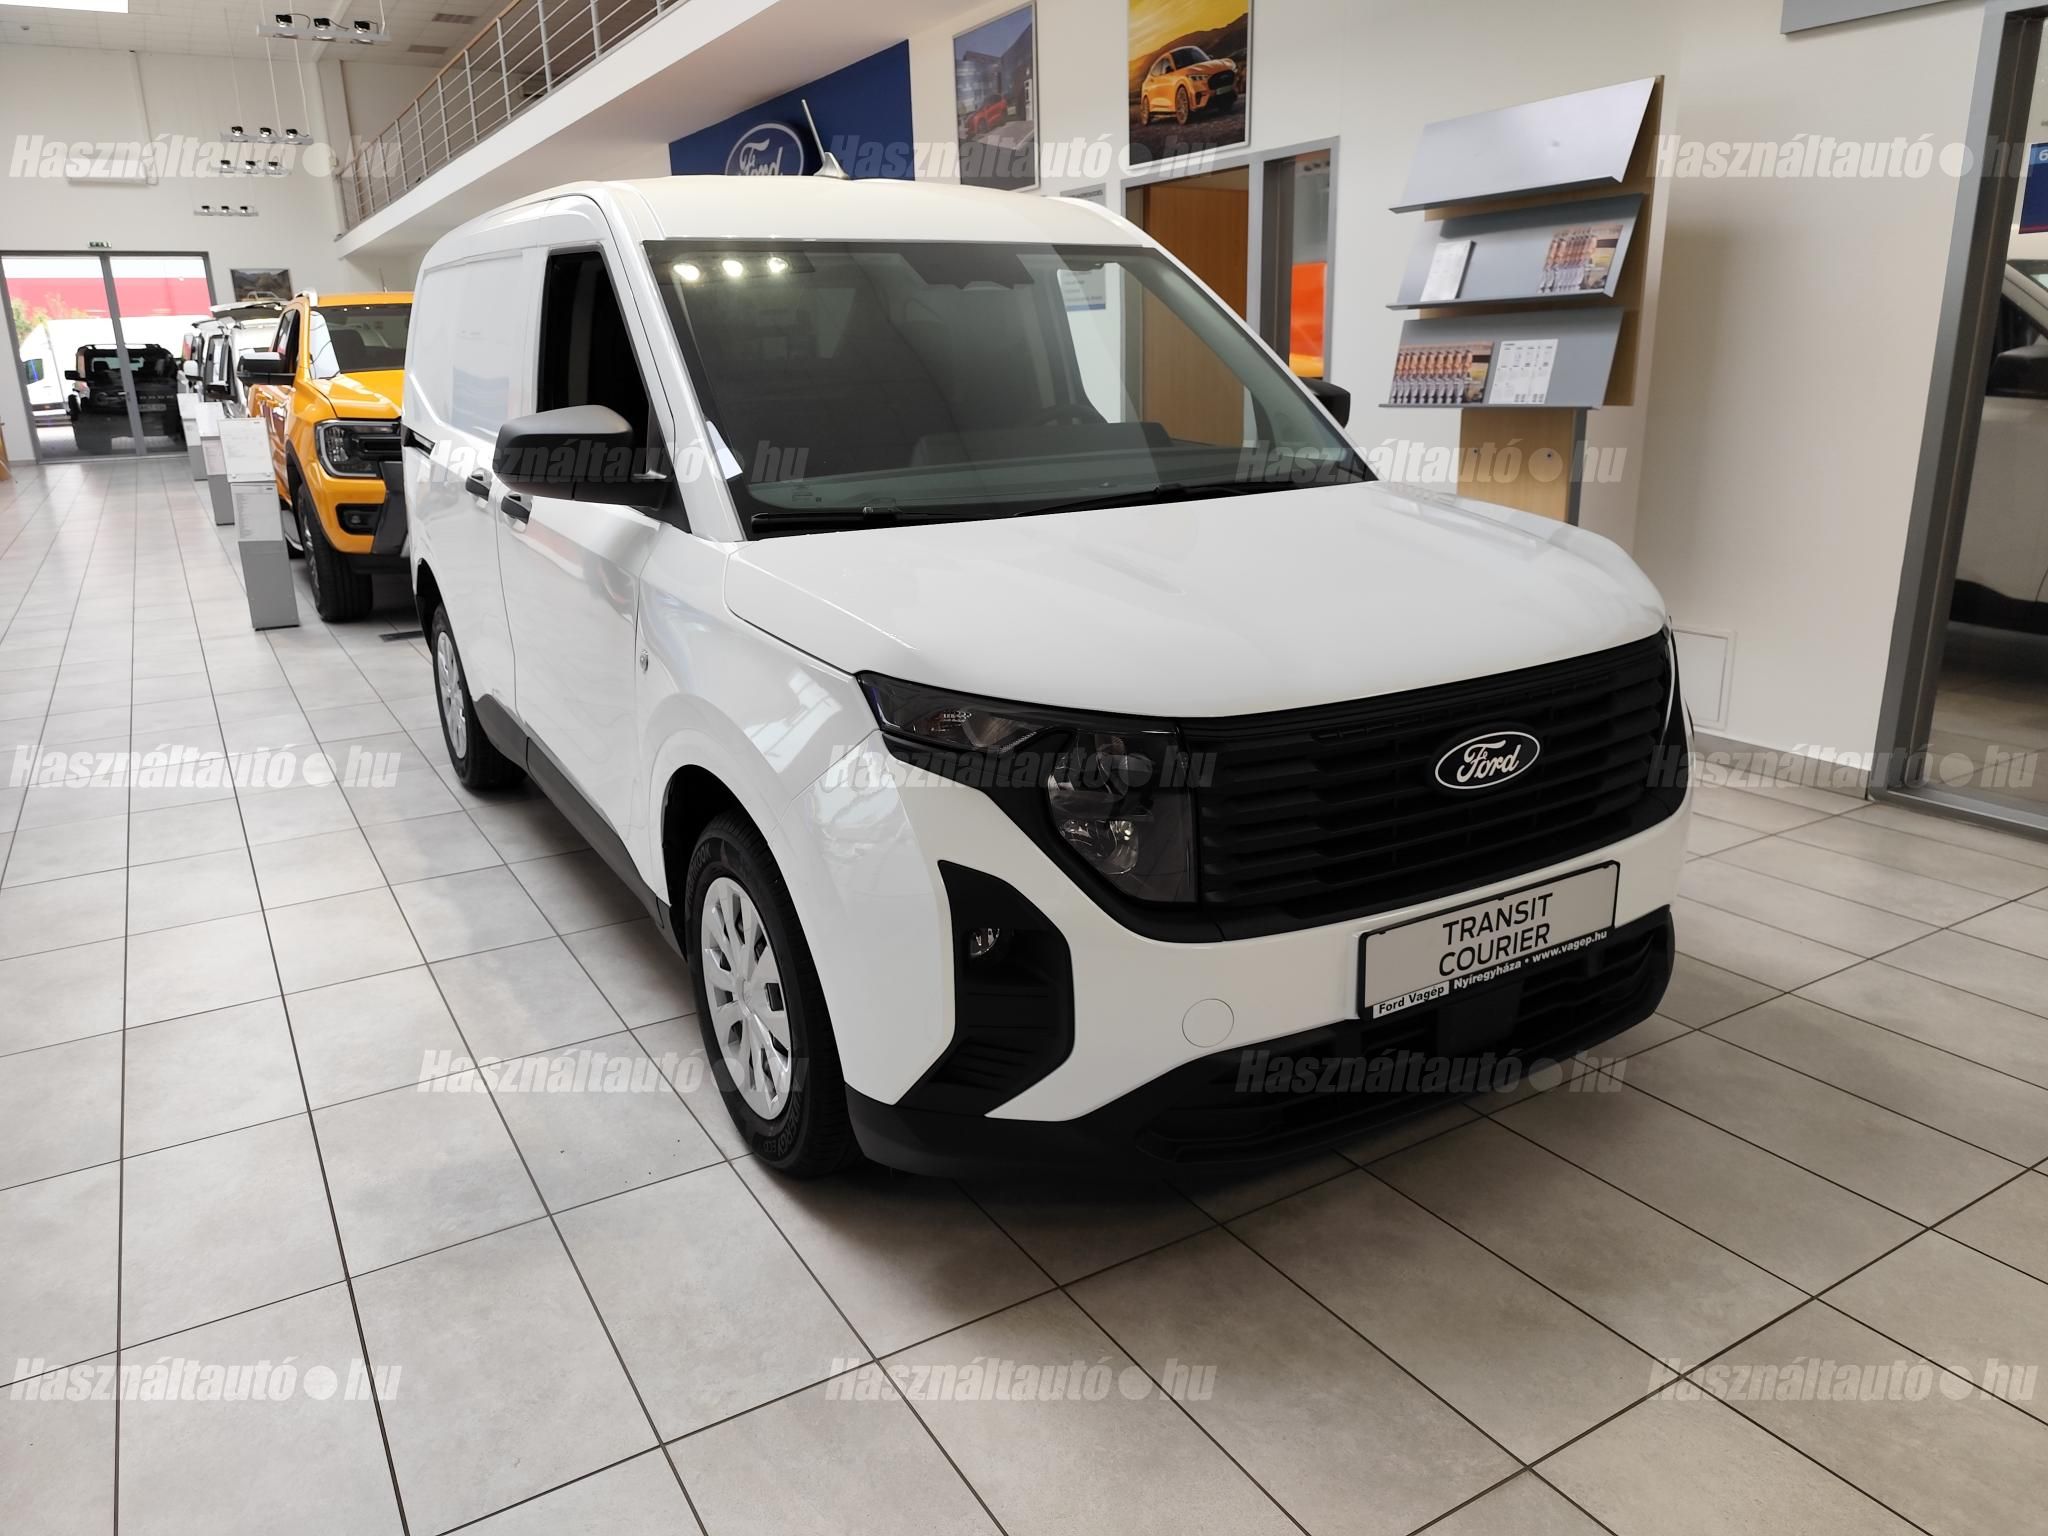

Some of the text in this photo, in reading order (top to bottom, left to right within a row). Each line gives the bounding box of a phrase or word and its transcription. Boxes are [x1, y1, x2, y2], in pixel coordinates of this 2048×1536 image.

[1456, 740, 1521, 783] Ford
[1442, 892, 1554, 946] TRANSIT
[1377, 995, 1406, 1015] Ford
[1531, 929, 1608, 964] www.vagep.hu
[1438, 922, 1551, 977] COURIER
